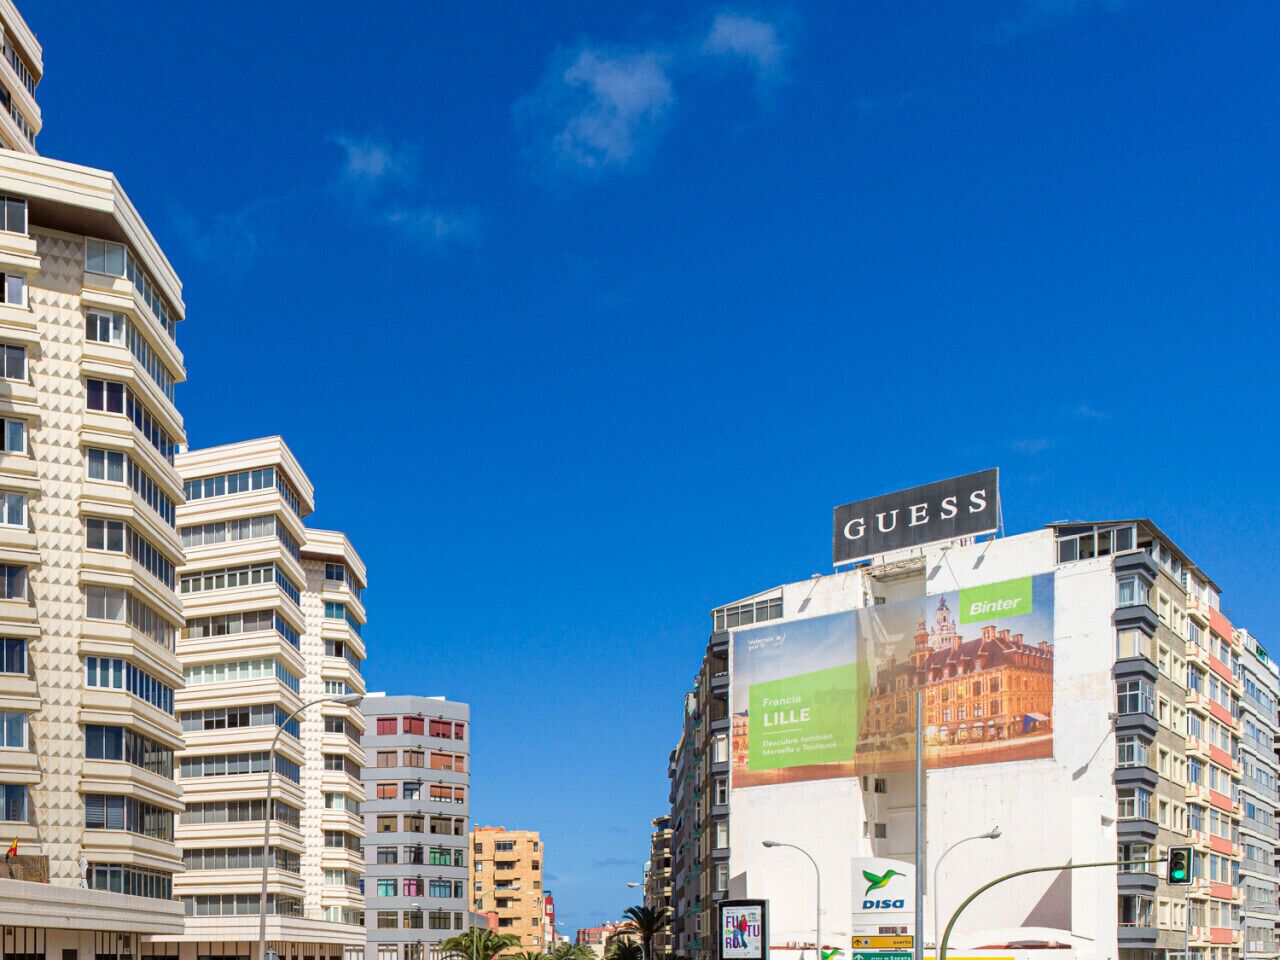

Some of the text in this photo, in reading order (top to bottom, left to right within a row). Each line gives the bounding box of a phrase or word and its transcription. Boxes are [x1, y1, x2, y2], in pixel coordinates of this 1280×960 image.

[843, 489, 987, 540] GUESS
[969, 597, 1022, 615] Binter
[763, 695, 801, 706] Francia
[763, 708, 810, 727] LILLE
[762, 738, 799, 747] Descubre
[746, 924, 760, 938] TU
